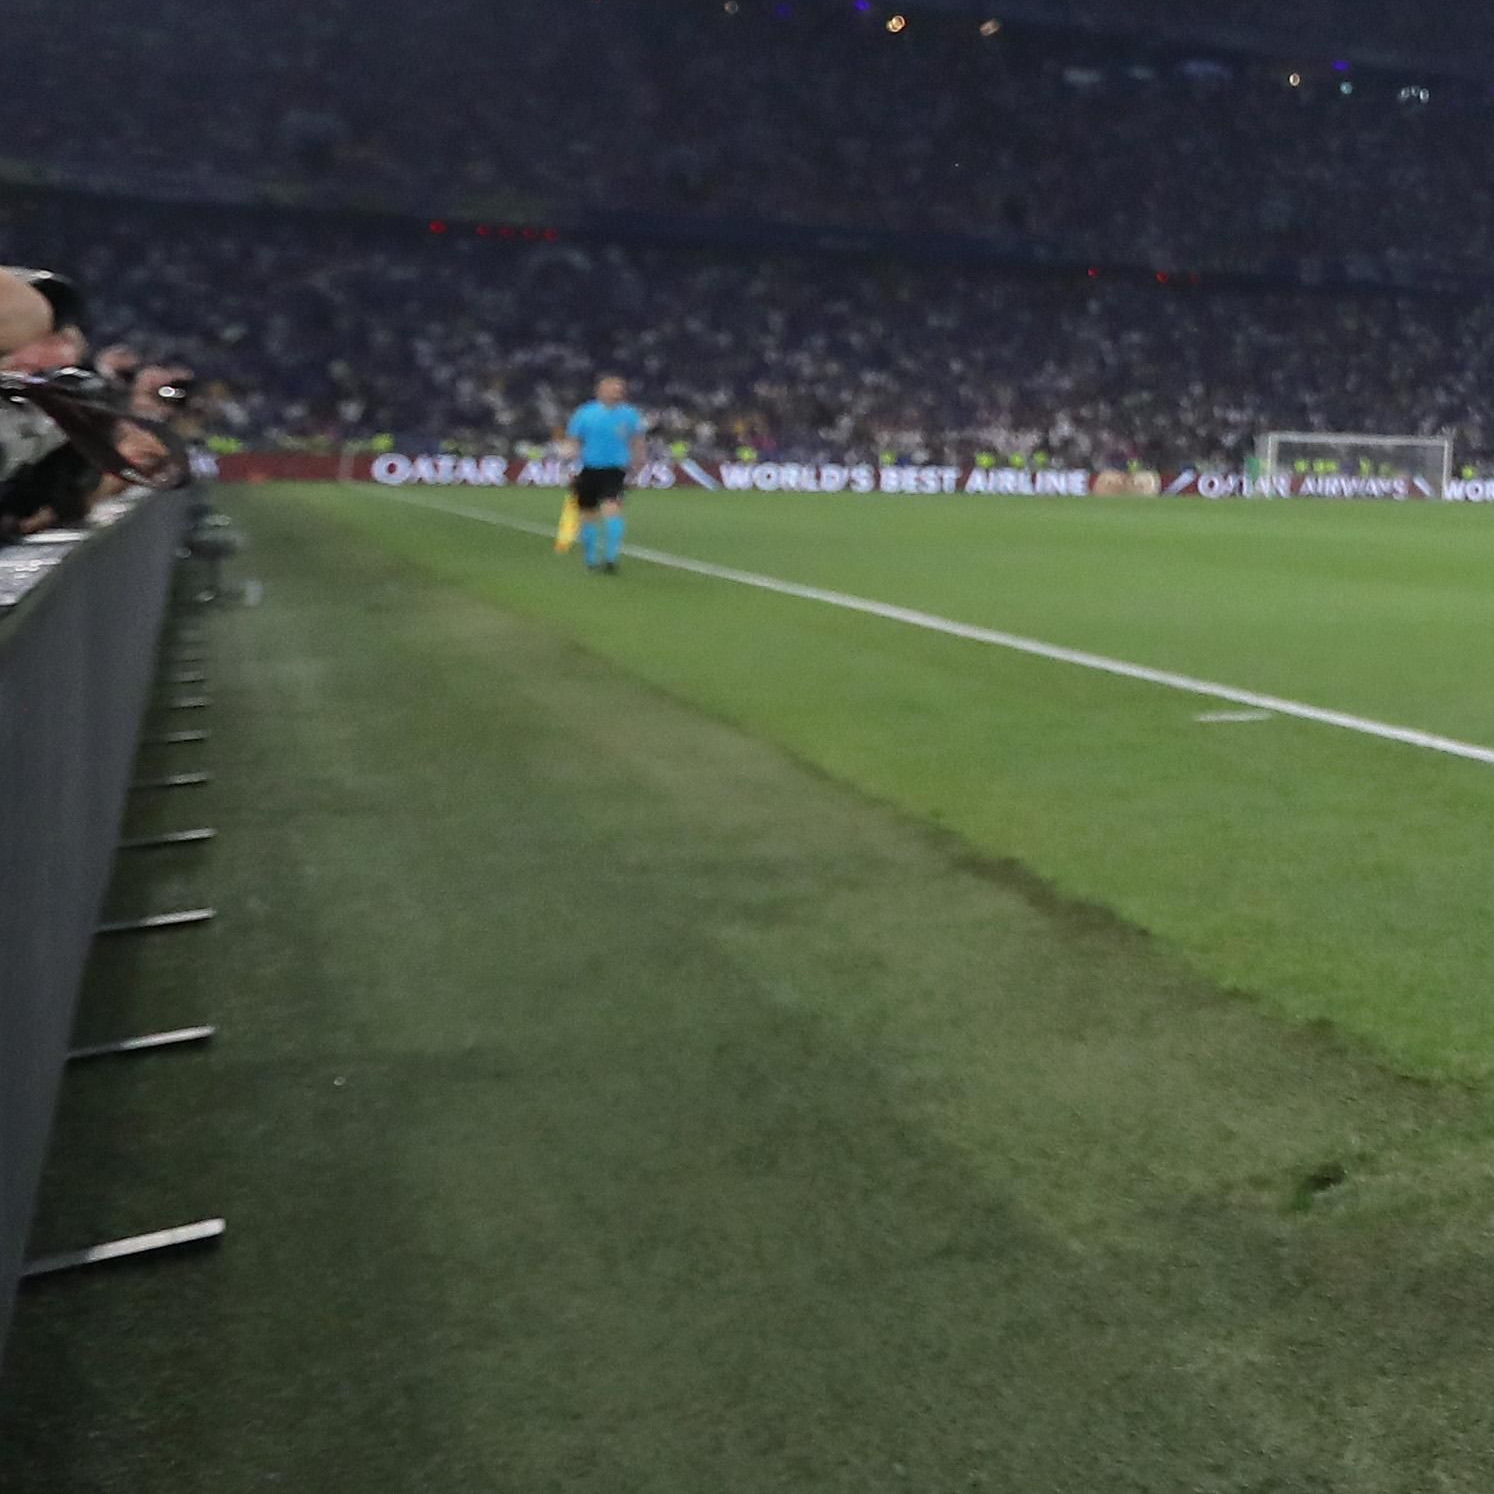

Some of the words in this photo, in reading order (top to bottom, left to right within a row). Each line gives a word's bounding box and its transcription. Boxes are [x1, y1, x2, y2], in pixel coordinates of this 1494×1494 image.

[371, 453, 507, 485] QATAR
[720, 462, 874, 493] WORLD'S
[880, 465, 959, 494] BEST
[964, 467, 1089, 496] AIRLINE
